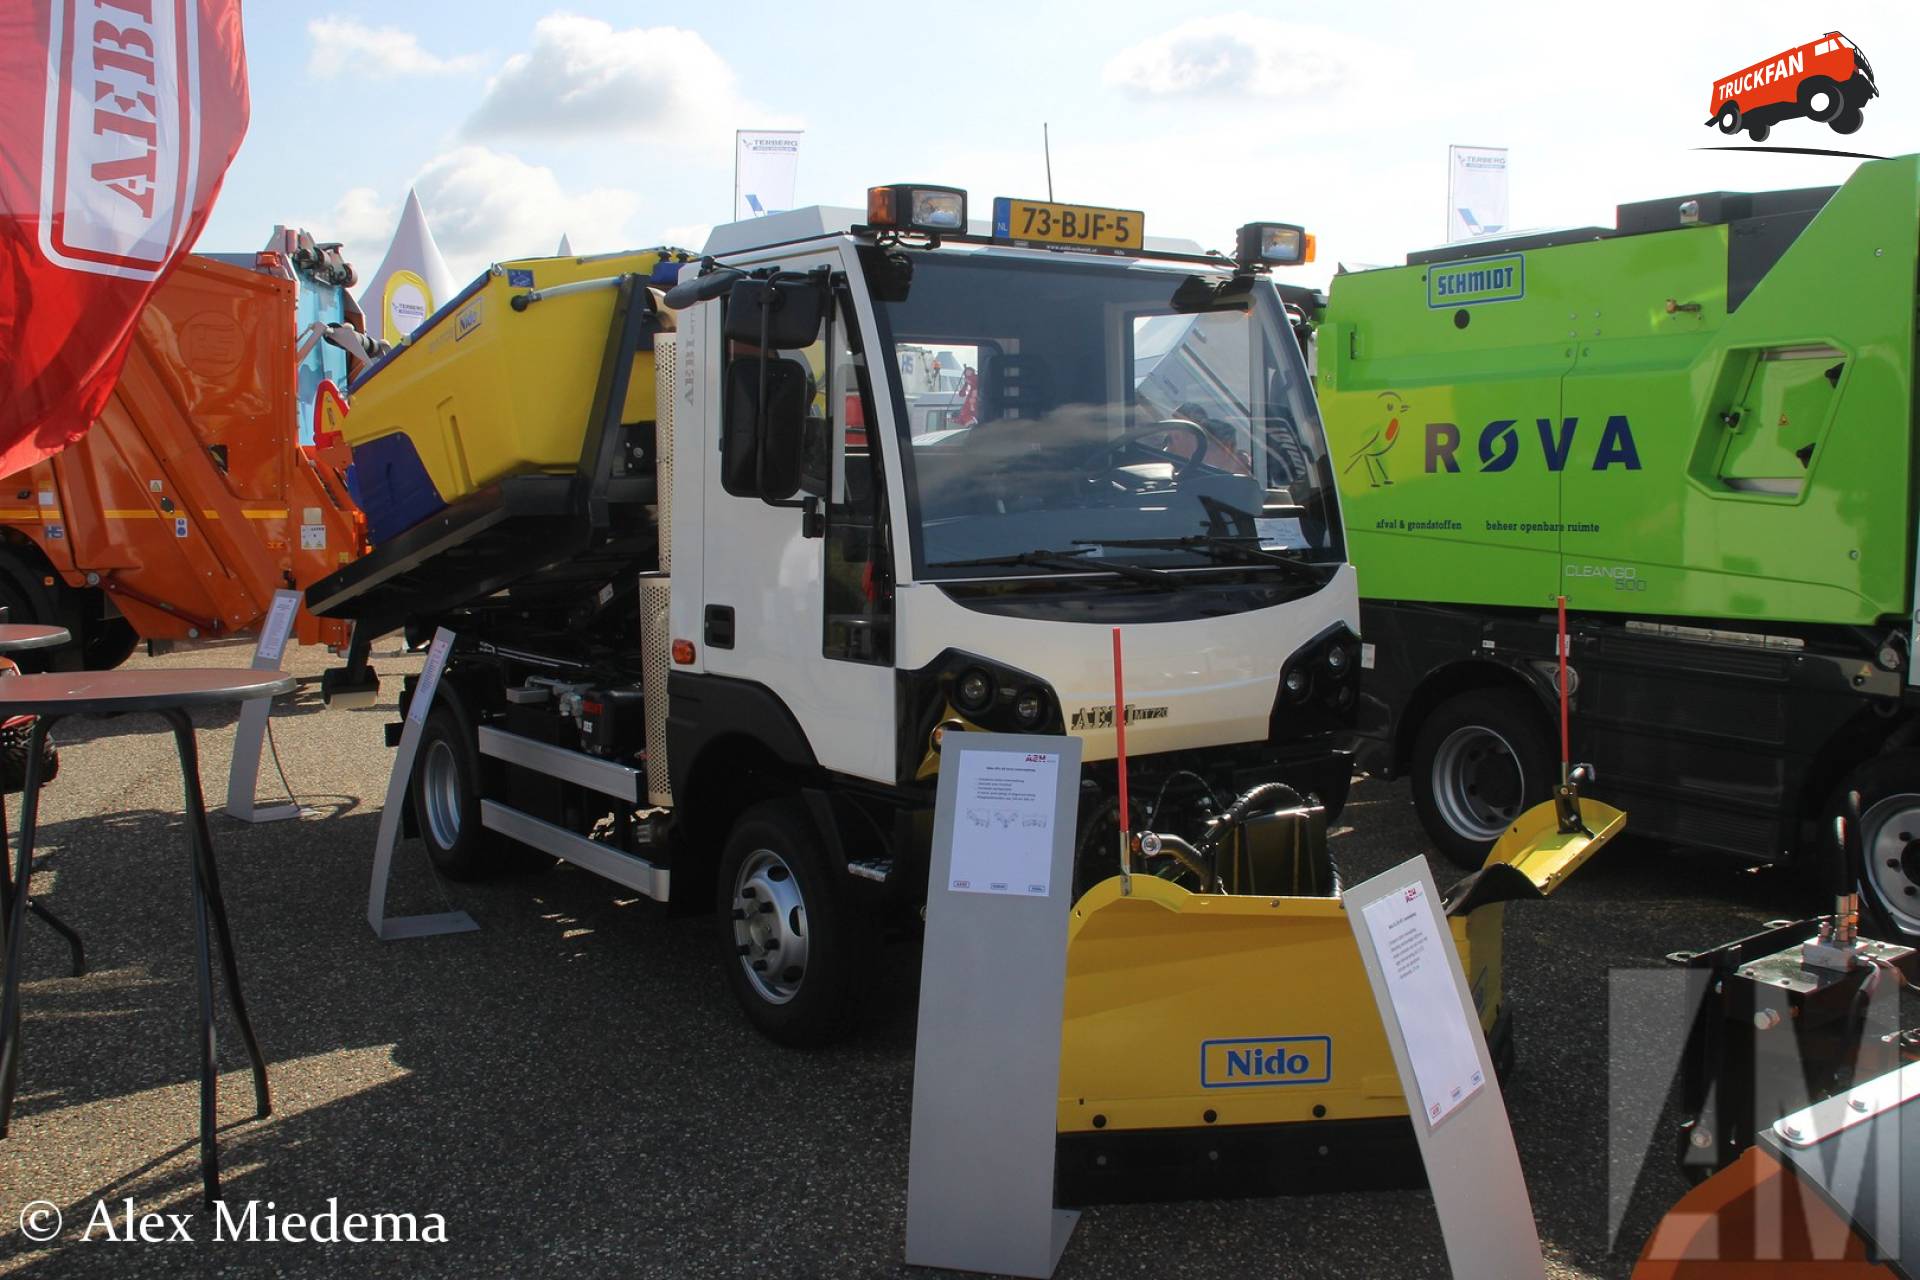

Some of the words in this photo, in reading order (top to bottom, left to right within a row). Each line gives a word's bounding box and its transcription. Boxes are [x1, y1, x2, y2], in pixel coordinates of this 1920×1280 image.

[997, 222, 1008, 232] NL
[1022, 206, 1130, 243] 73-BJF-5
[1437, 267, 1514, 296] SCHMIDT
[1375, 519, 1397, 529] afval
[1407, 519, 1462, 532] grondstoffen
[1486, 520, 1517, 531] beheer
[1520, 521, 1565, 533] openbare
[1567, 522, 1600, 532] ruimte
[1565, 564, 1636, 579] CLEANGO
[1615, 578, 1647, 592] 500
[1227, 1048, 1310, 1077] Nido
